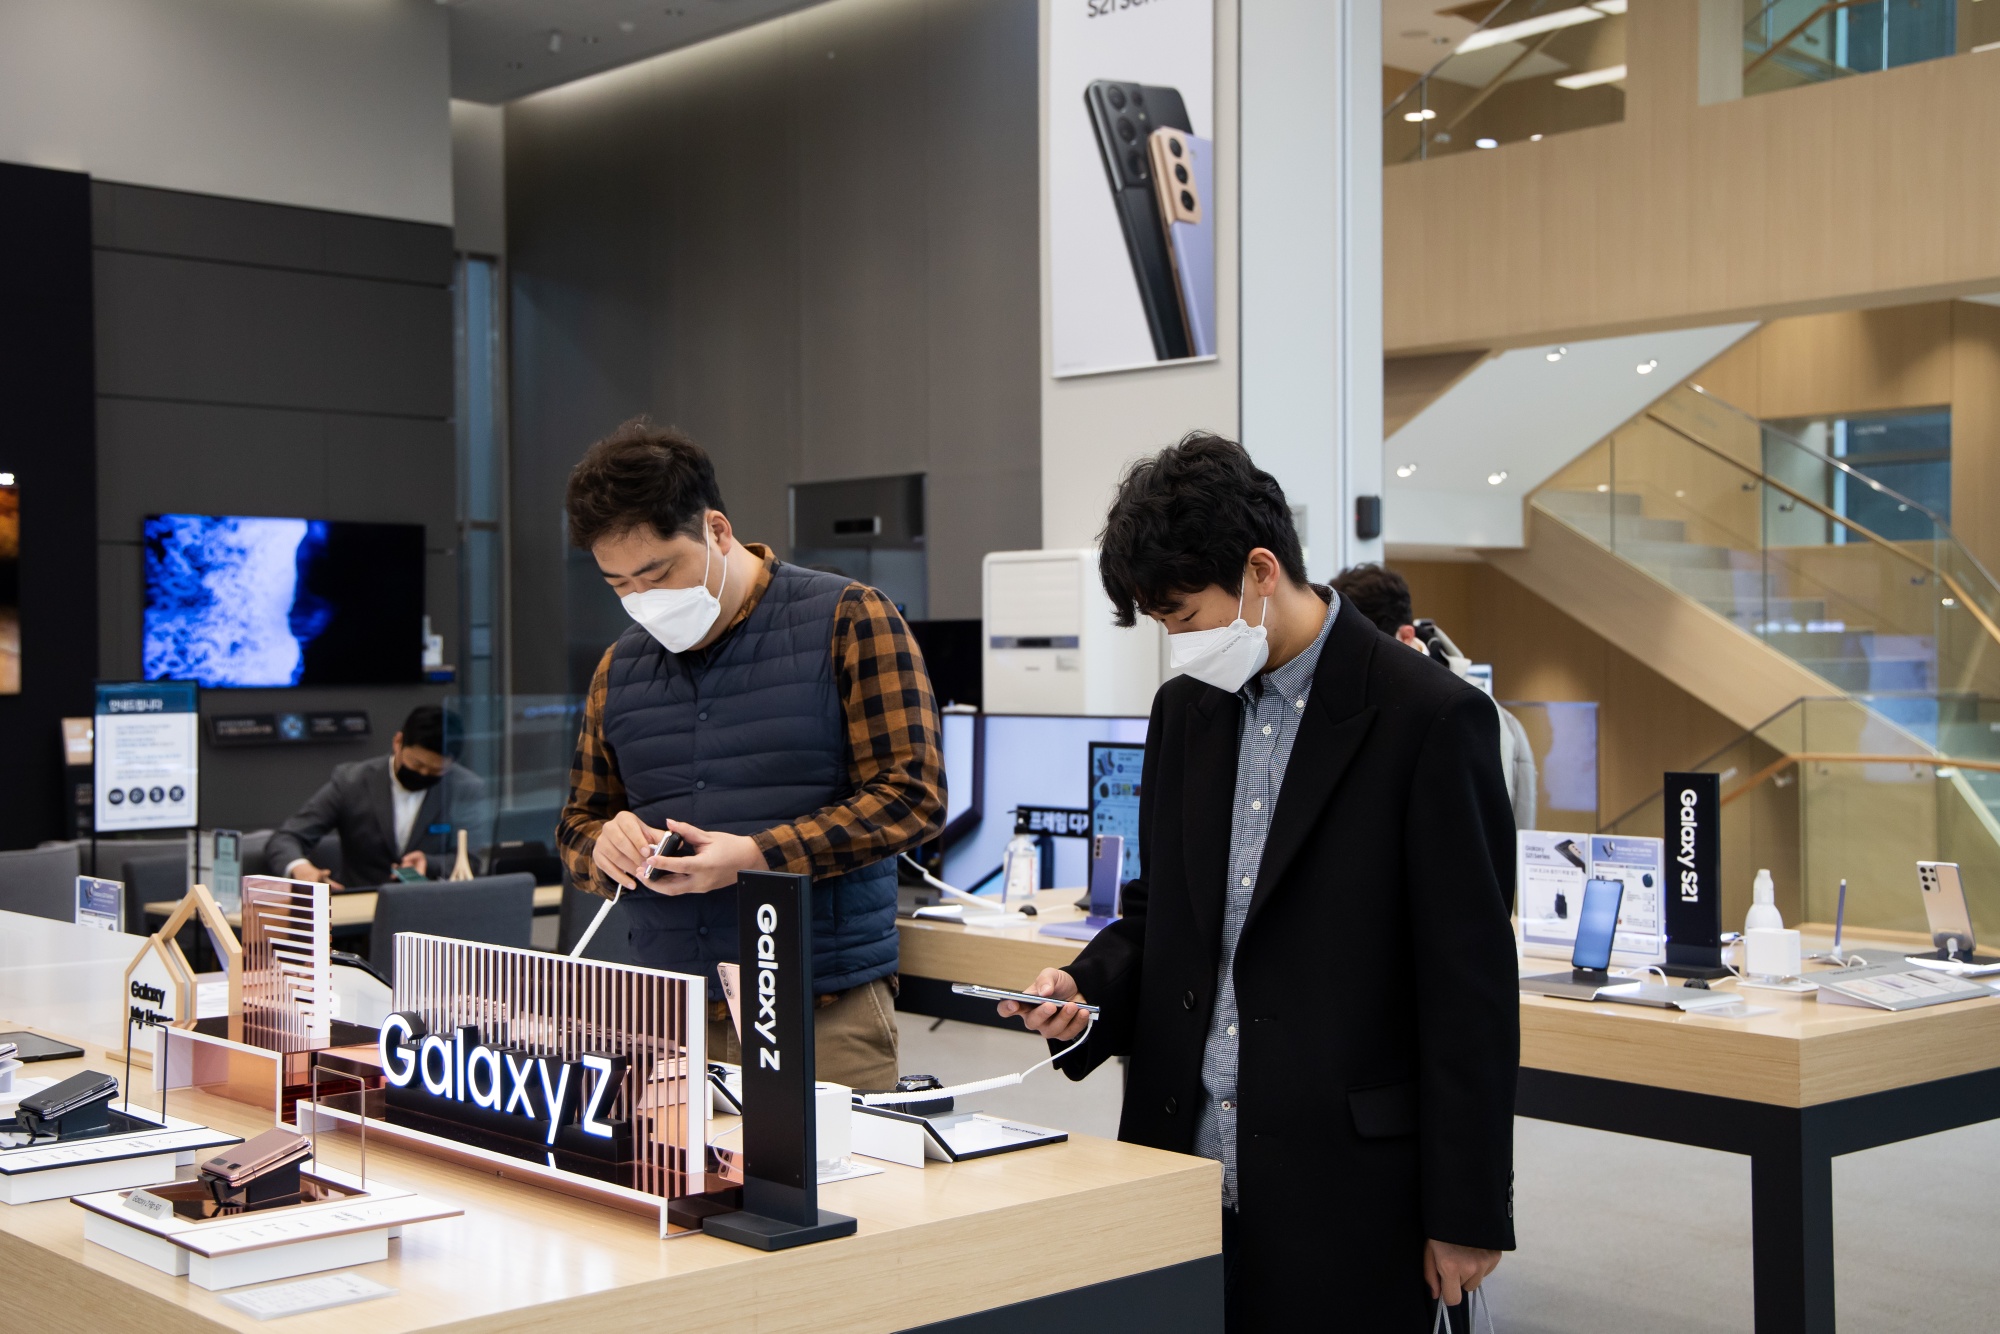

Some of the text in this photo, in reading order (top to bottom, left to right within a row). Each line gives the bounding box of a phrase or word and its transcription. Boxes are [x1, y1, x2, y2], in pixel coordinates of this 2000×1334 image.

[1088, 0, 1115, 18] S21
[1029, 811, 1068, 834] 프레임
[1676, 789, 1699, 902] Galaxy S21
[131, 980, 166, 1009] Galaxy
[754, 903, 781, 1071] Galaxy Z
[145, 1009, 174, 1027] Ho
[379, 1012, 613, 1145] Galaxy Z
